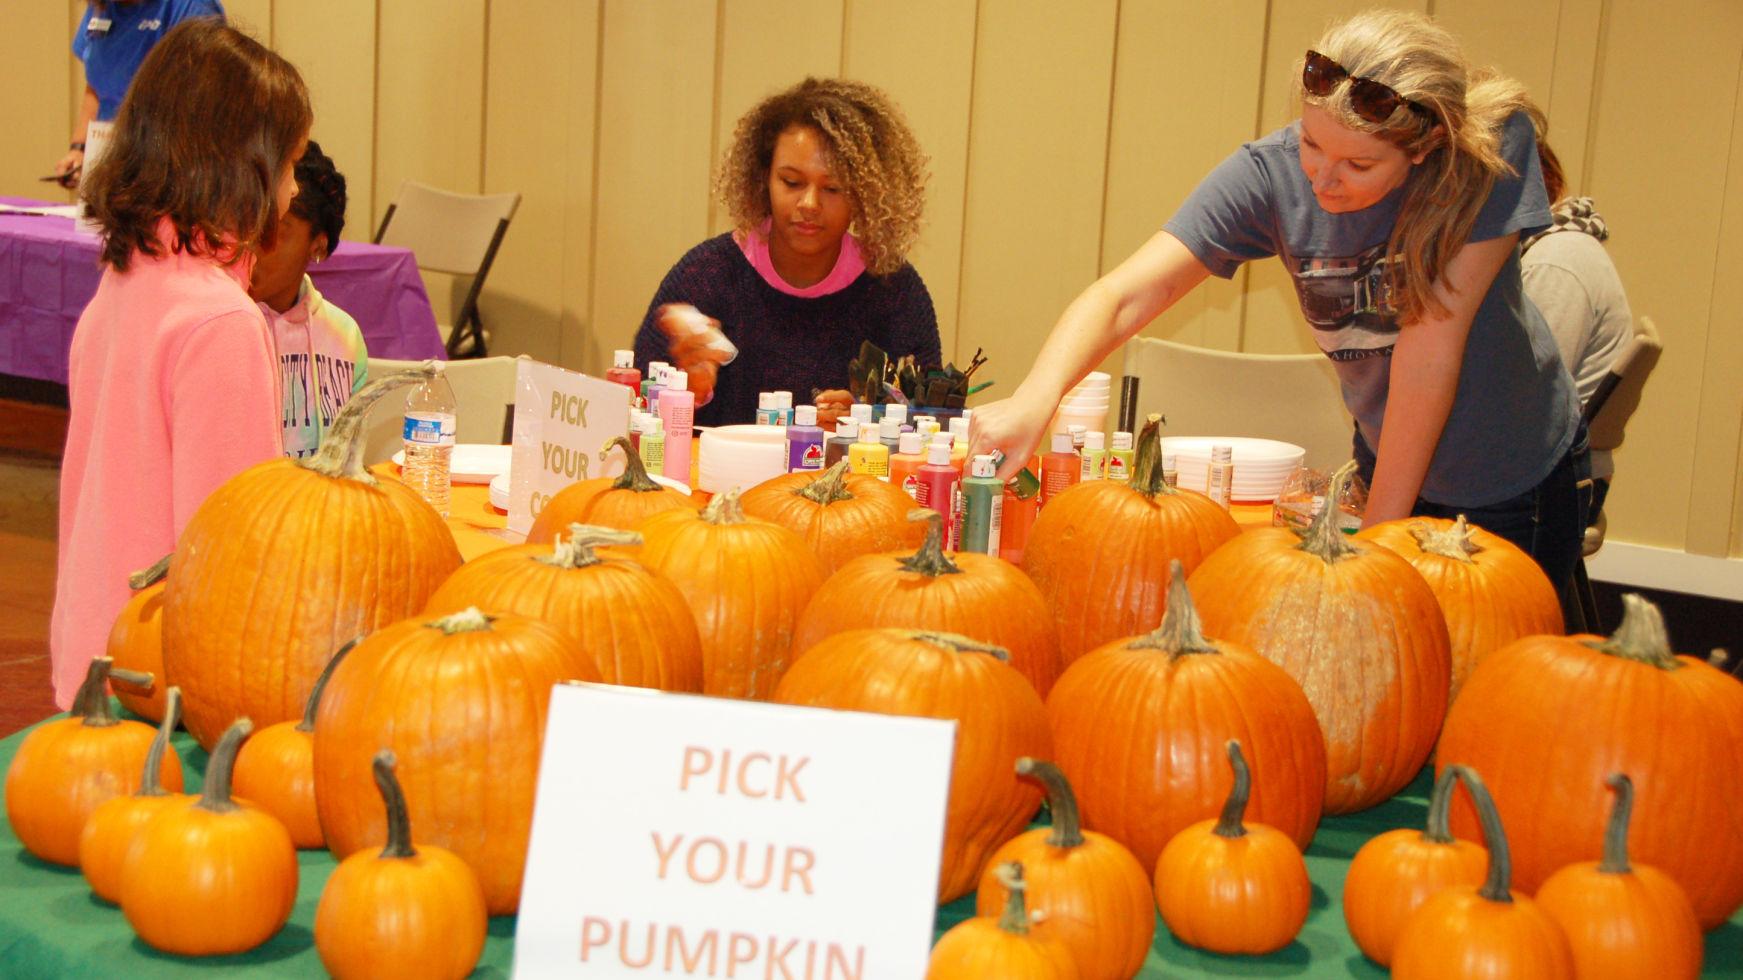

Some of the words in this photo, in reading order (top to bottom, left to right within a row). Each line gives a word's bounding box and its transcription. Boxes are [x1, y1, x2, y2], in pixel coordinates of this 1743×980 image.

[551, 391, 589, 428] PICK
[542, 441, 590, 481] YOUR
[530, 491, 552, 519] CO
[679, 745, 811, 802] PICK
[650, 831, 817, 895] YOUR
[579, 916, 866, 980] PUMPKIN
